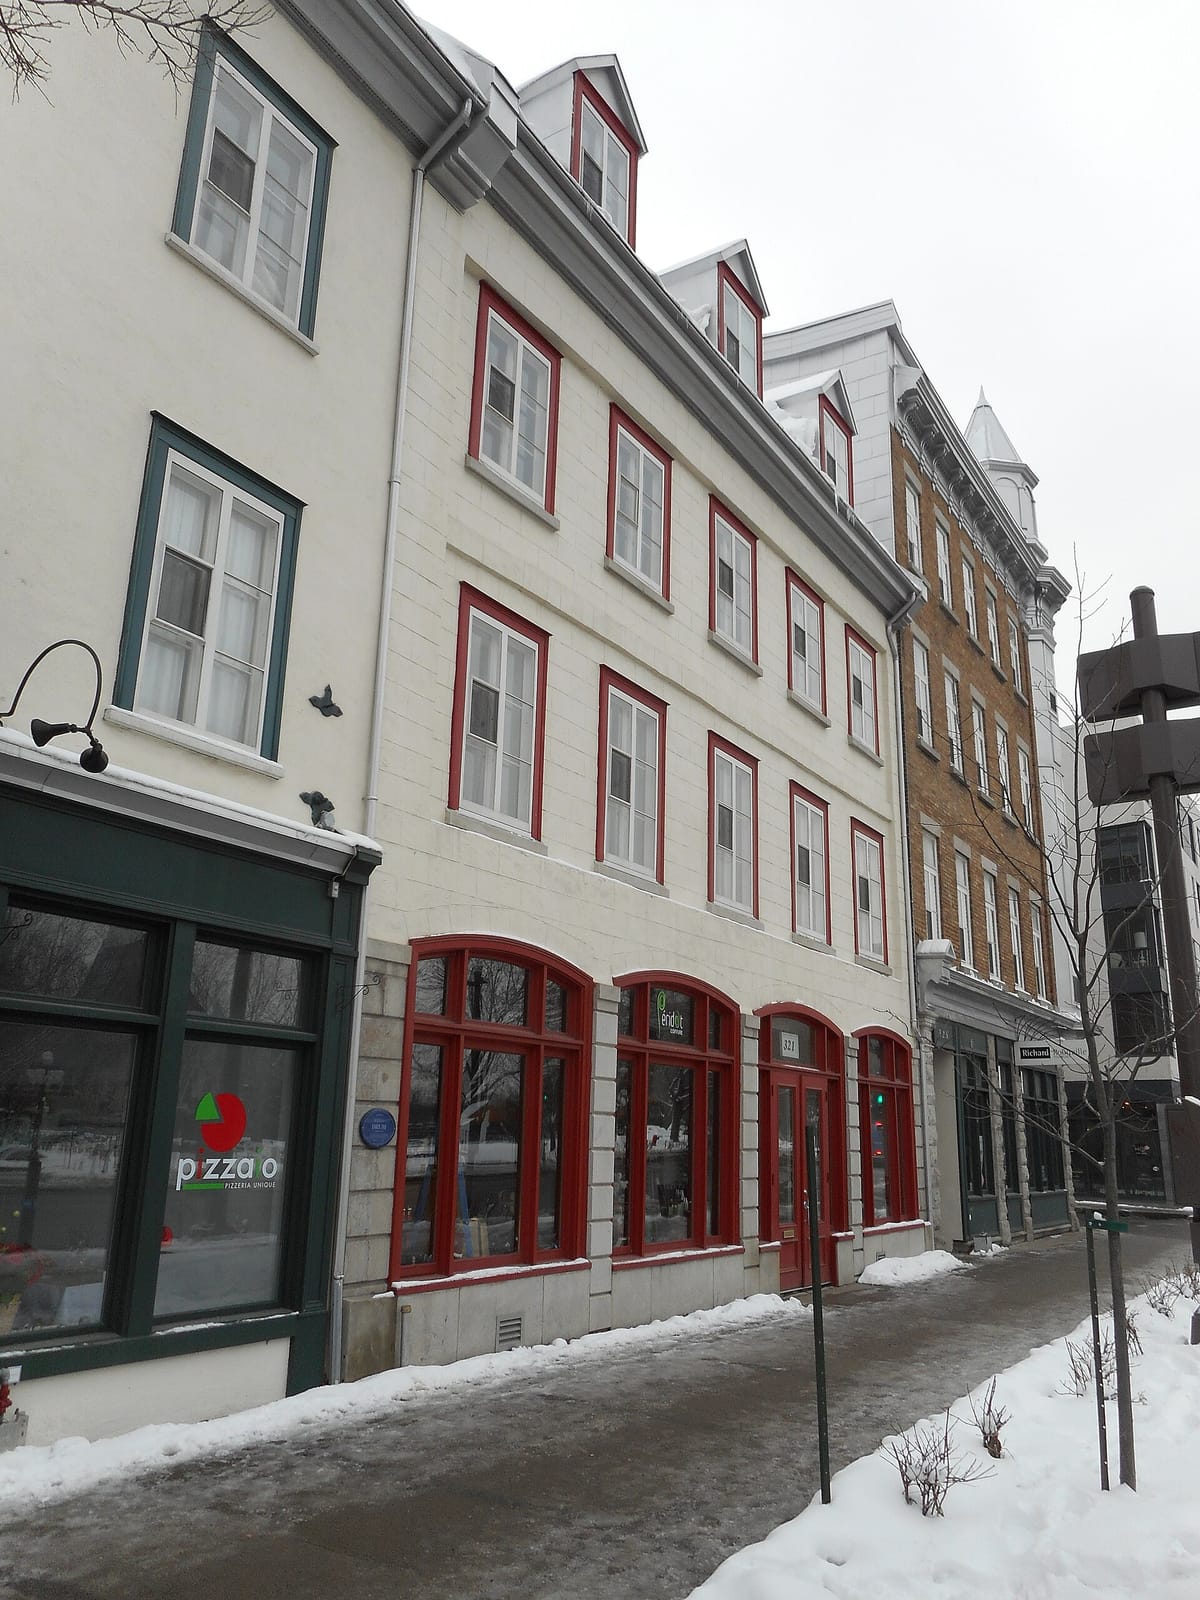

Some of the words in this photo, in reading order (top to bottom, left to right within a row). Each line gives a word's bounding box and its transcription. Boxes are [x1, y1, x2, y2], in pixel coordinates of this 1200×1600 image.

[783, 1039, 795, 1052] 321
[1022, 1048, 1049, 1057] Richard
[175, 1146, 278, 1191] pizzaio
[253, 1181, 277, 1189] UNIQUE
